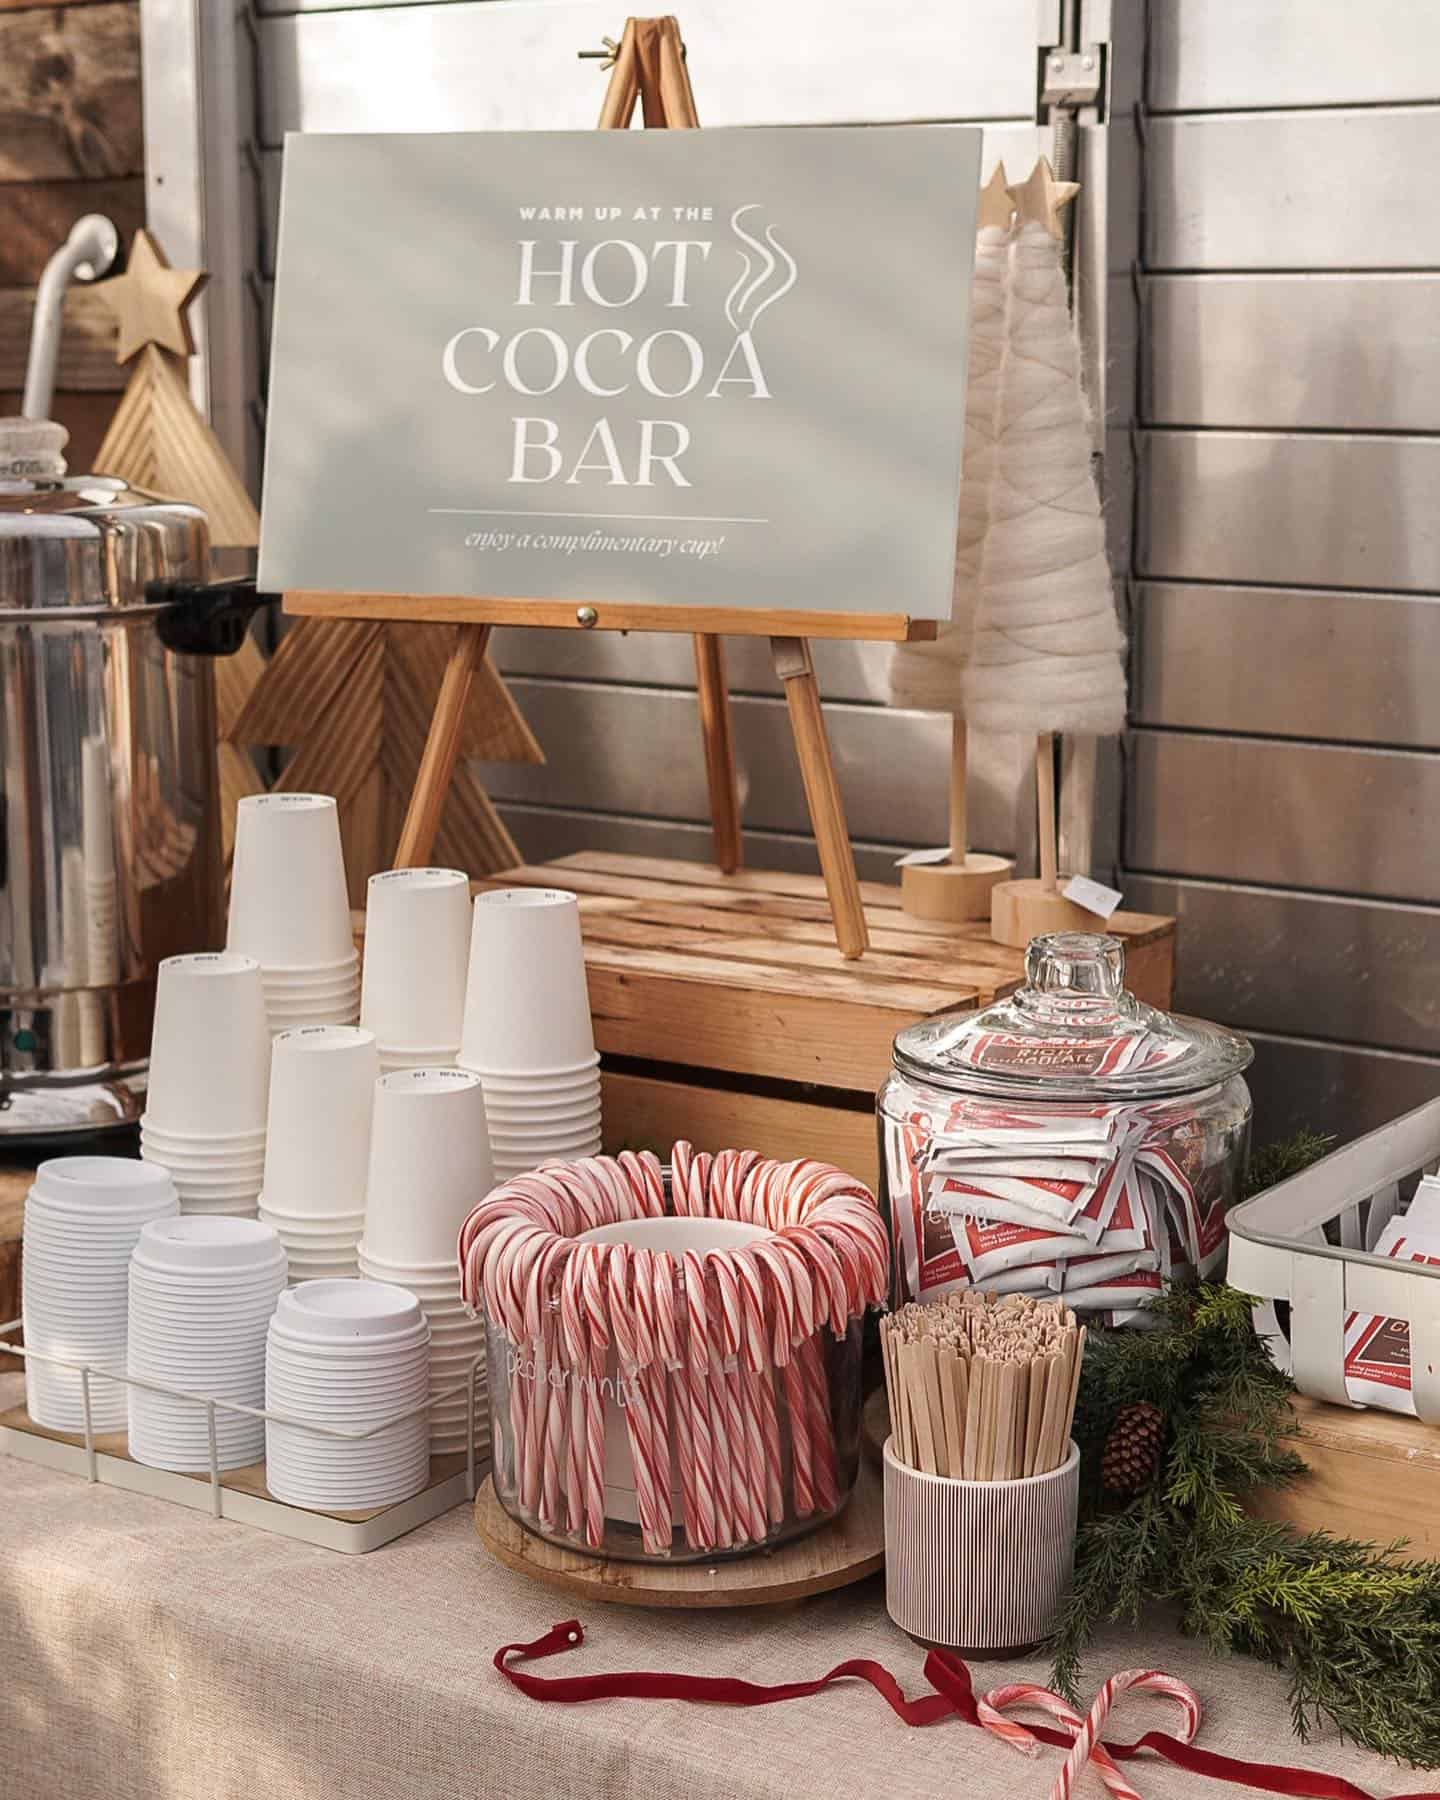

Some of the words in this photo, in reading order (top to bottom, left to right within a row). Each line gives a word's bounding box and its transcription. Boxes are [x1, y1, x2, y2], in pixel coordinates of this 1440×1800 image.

[519, 207, 583, 221] WARM
[595, 207, 622, 221] UP
[632, 207, 662, 221] AT
[673, 207, 713, 221] THE
[514, 239, 712, 307] HOT
[442, 327, 773, 399] COCOA
[507, 417, 692, 487] BAR
[465, 529, 515, 552] enjoy
[516, 535, 530, 548] a
[532, 530, 678, 557] complimentary
[680, 536, 726, 559] cup!
